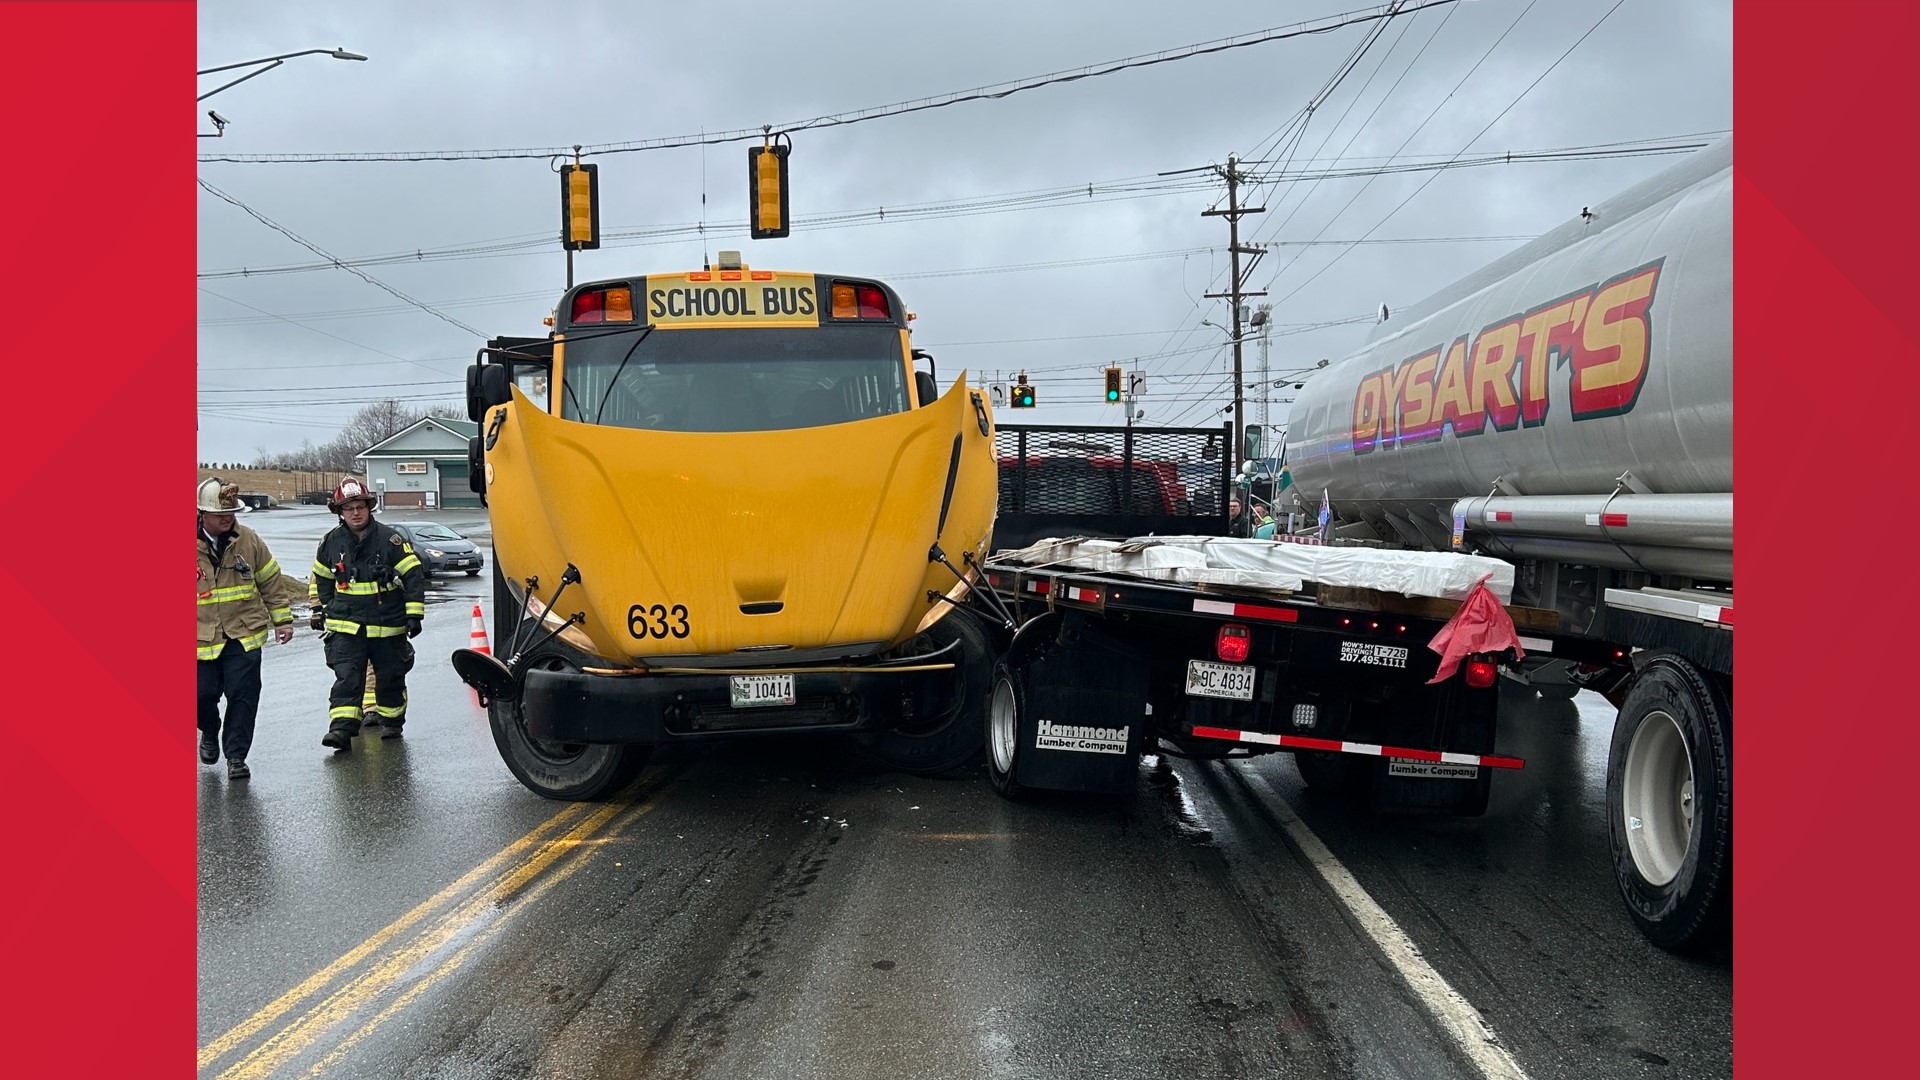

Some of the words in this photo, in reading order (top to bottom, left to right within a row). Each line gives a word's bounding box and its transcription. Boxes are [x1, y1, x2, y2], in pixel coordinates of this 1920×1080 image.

[650, 288, 756, 318] SCHOOL
[763, 287, 814, 316] BUS
[1353, 258, 1664, 454] DYSART'S
[627, 604, 690, 640] 633
[1341, 647, 1373, 655] DRIVING?
[1342, 641, 1363, 649] HOW'S
[1375, 646, 1406, 658] T-728
[1340, 652, 1406, 668] 207.495.1111
[755, 681, 791, 698] 10414
[1203, 688, 1236, 697] COMMERCIAL
[1037, 719, 1130, 740] Hammond
[1038, 737, 1075, 748] Lumber
[1078, 740, 1125, 752] Company
[1391, 764, 1428, 774] Lumber
[1430, 766, 1477, 777] Company
